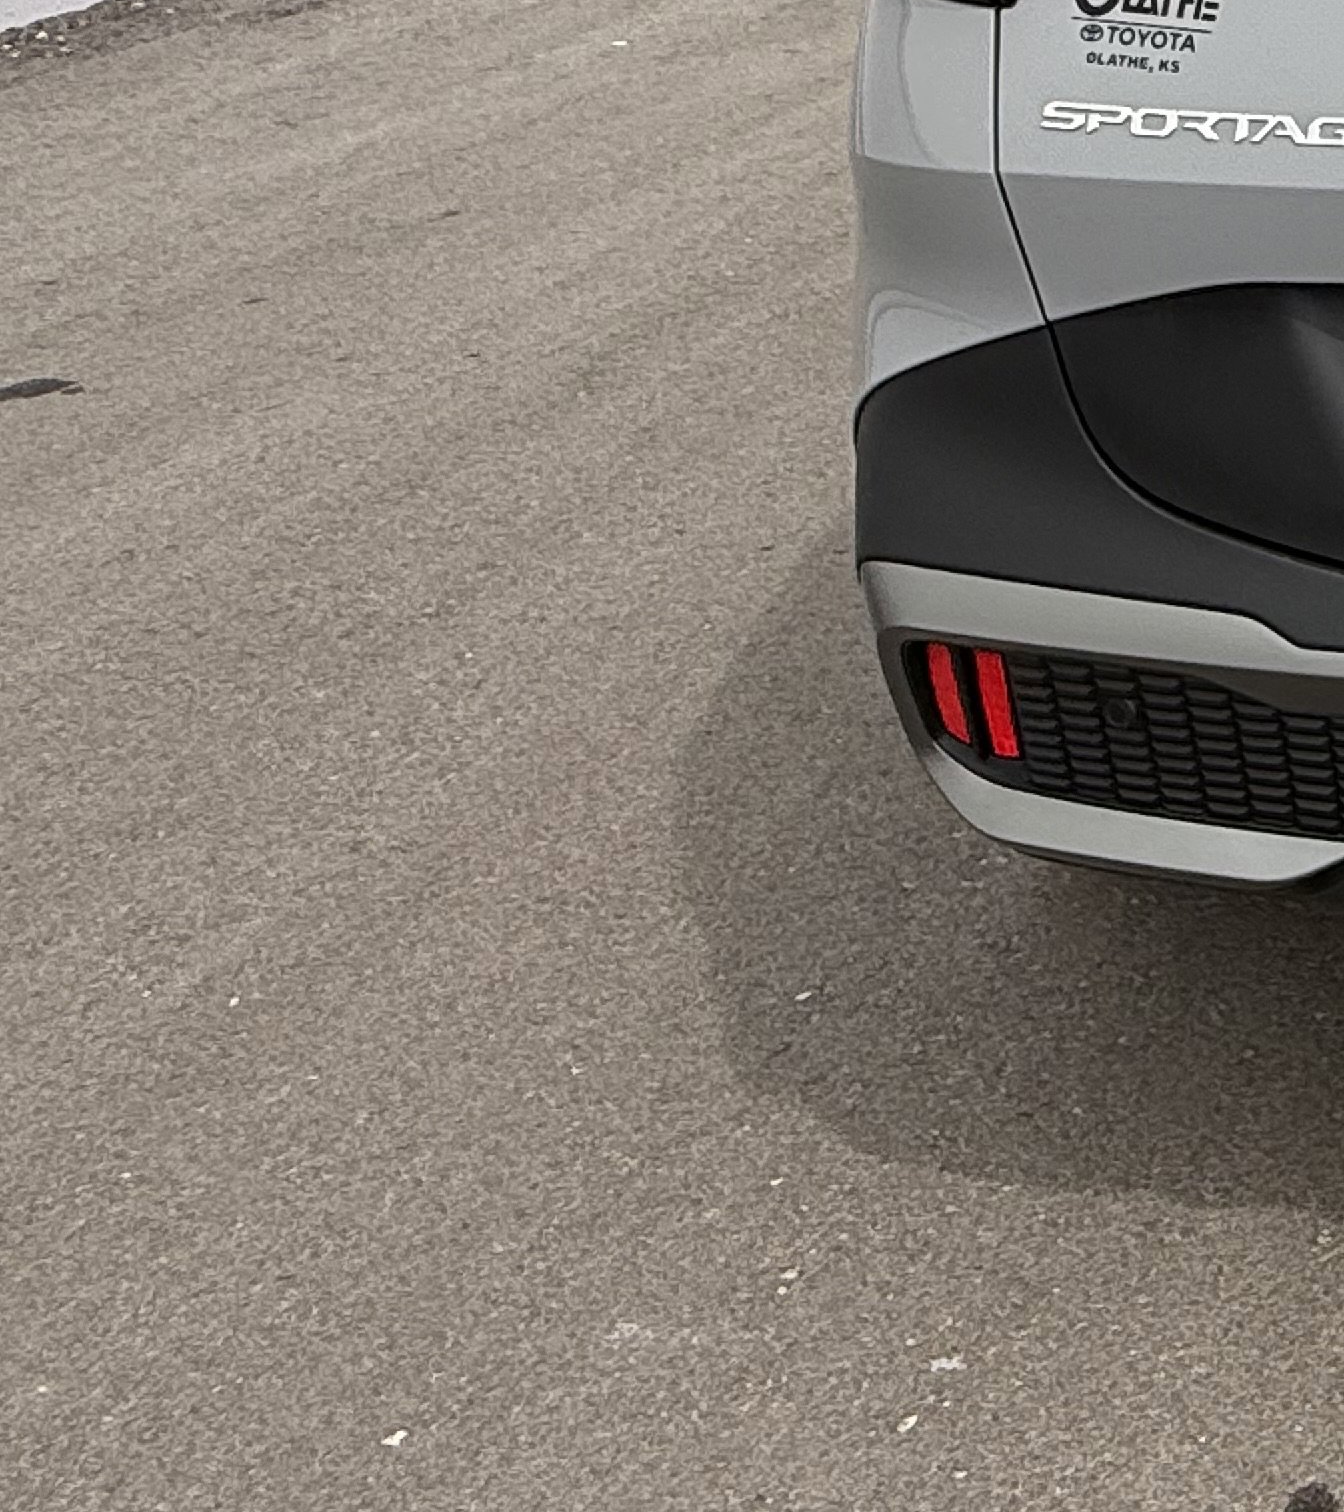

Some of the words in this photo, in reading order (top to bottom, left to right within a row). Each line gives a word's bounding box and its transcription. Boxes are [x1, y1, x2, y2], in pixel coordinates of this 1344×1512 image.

[1107, 26, 1196, 53] TOYOTA
[1086, 51, 1154, 73] OLATHE,
[1158, 58, 1180, 73] KS
